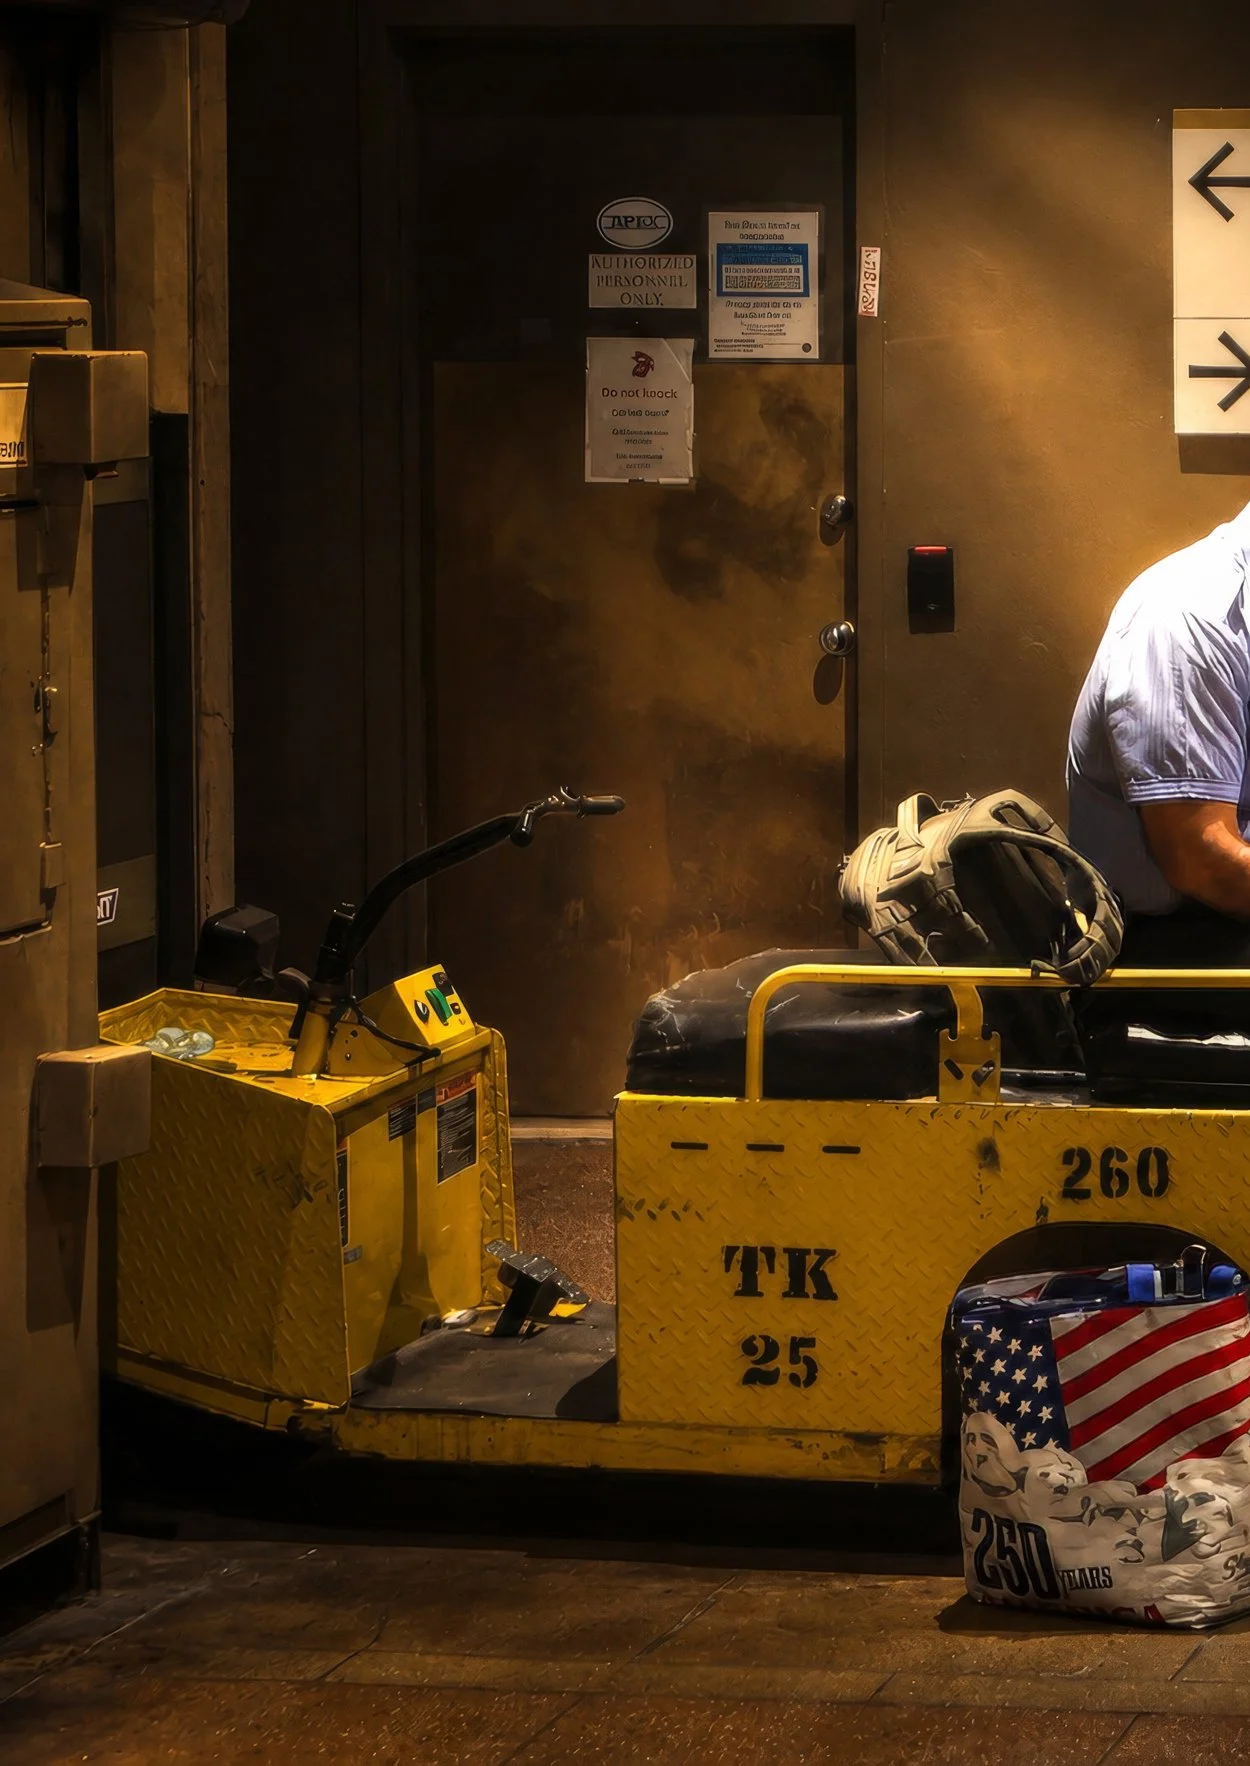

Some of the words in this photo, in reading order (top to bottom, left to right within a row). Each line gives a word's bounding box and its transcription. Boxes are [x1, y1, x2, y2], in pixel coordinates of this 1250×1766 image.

[602, 388, 617, 398] Do
[1061, 1146, 1174, 1199] 260
[723, 1245, 839, 1301] TK
[741, 1335, 819, 1389] 25
[971, 1507, 1060, 1600] 250
